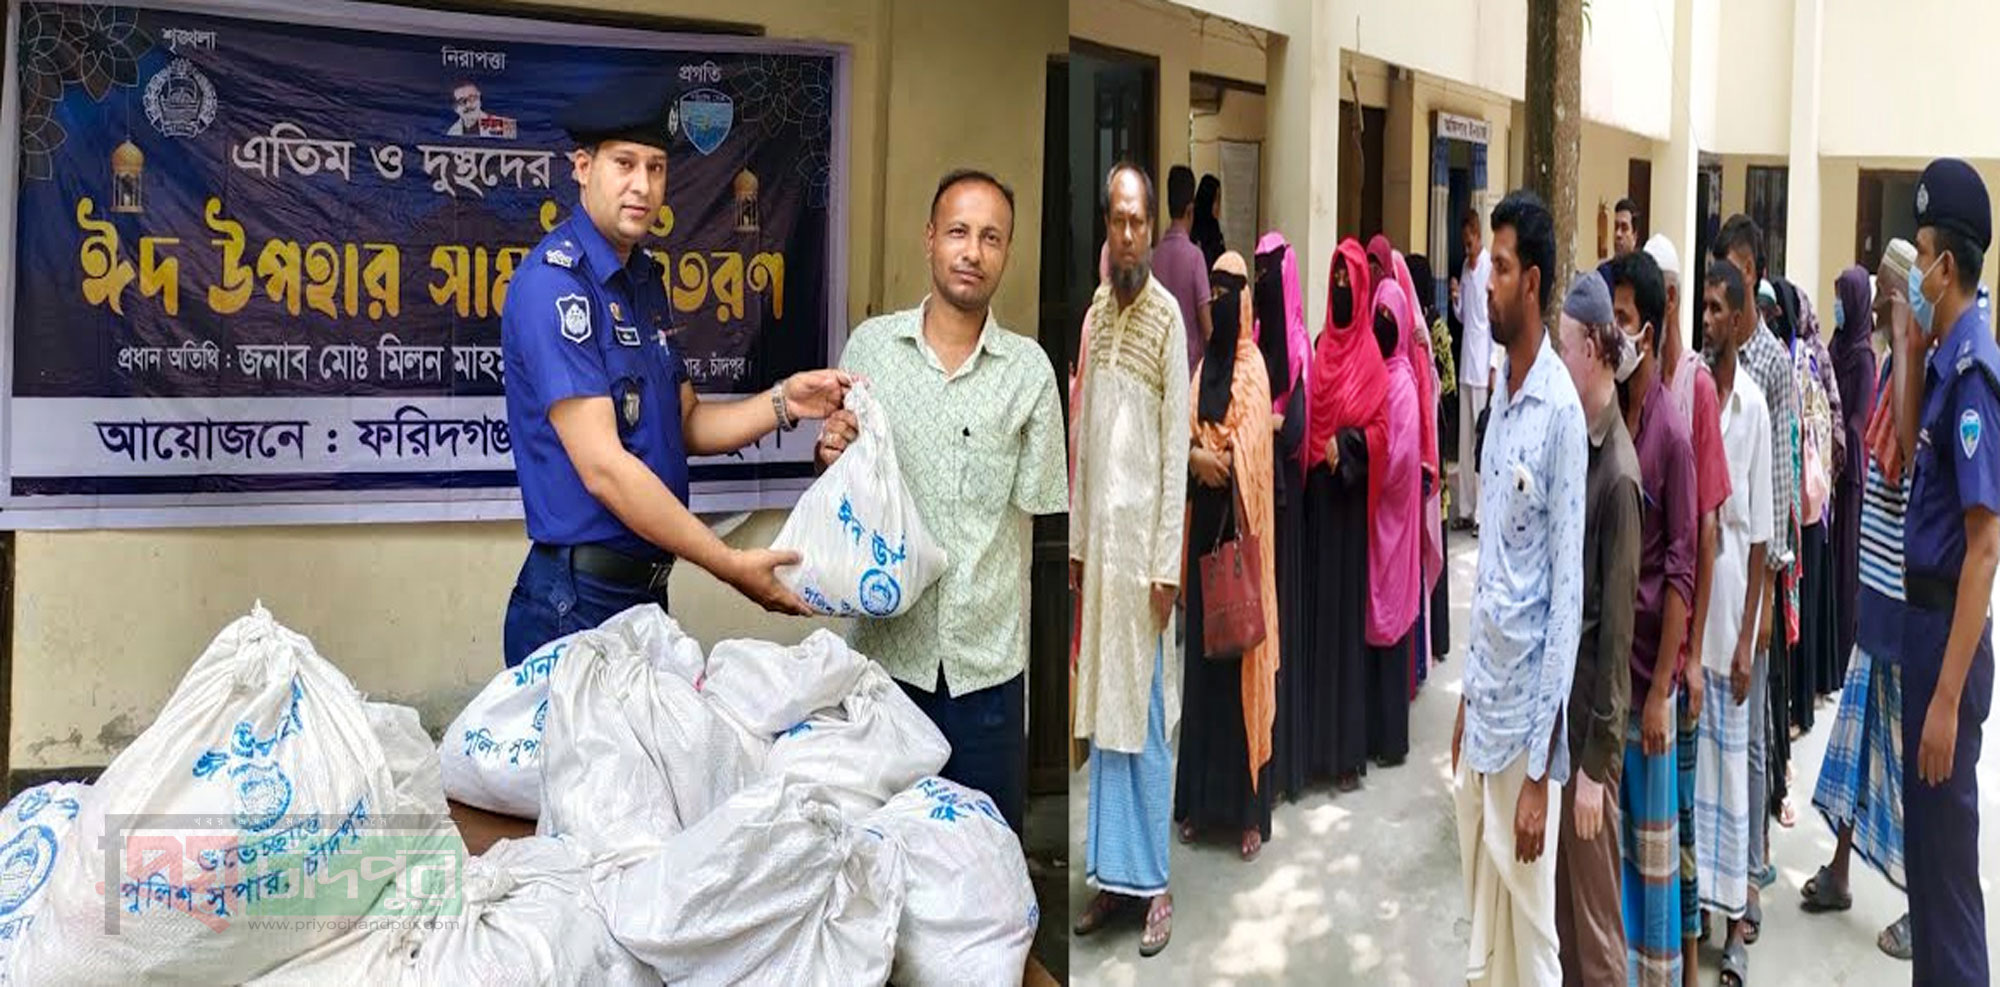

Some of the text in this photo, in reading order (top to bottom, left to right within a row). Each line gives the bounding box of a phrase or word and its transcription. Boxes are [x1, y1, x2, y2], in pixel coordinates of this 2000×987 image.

[441, 46, 506, 70] নিরাপত্তা
[232, 122, 357, 181] এতিম
[370, 145, 404, 180] ও
[417, 144, 556, 198] দুস্থদের
[76, 197, 181, 316] ঈদ
[204, 197, 402, 321] উপহার
[117, 344, 162, 373] প্রধান
[168, 341, 220, 372] অতিথি
[237, 342, 310, 382] জনাব
[318, 342, 369, 379] মোঃ
[377, 333, 445, 382] মিলন
[93, 418, 311, 462] আয়োজনে
[121, 872, 194, 916] পুলিশ
